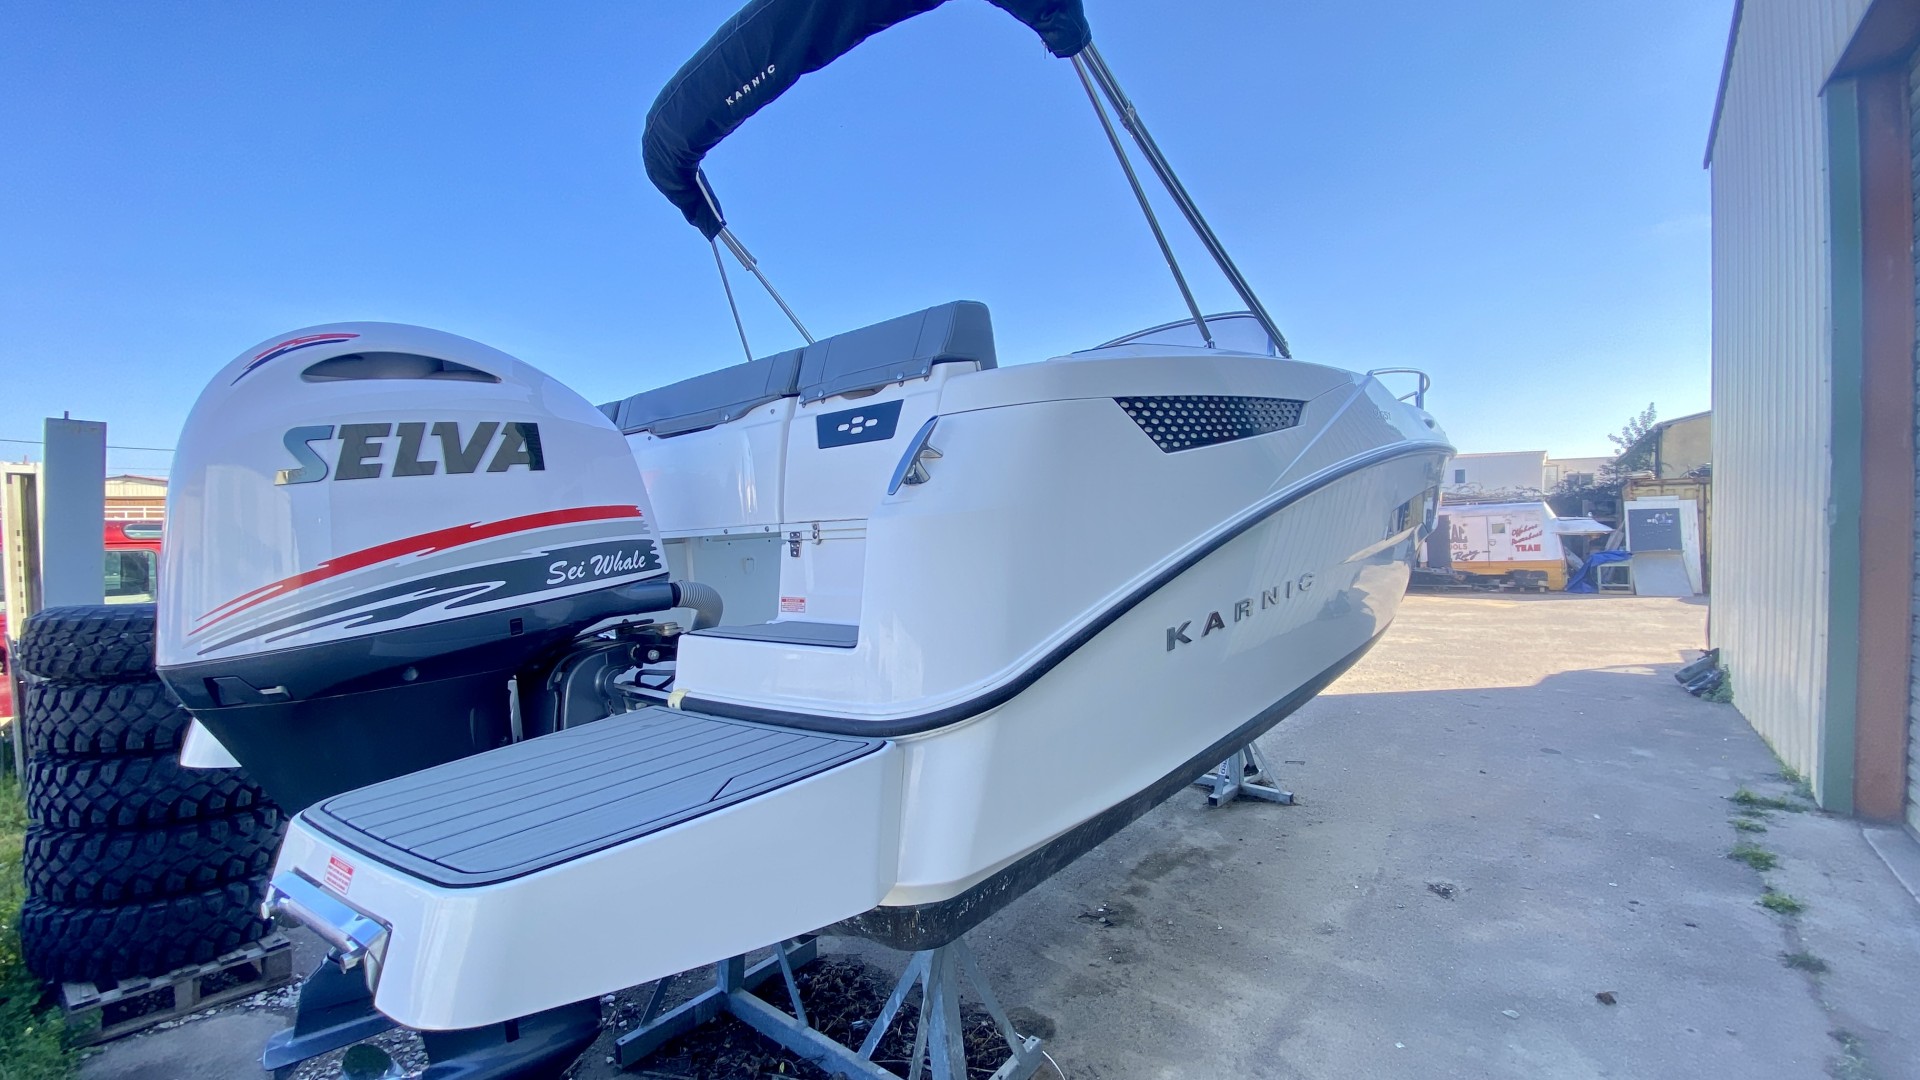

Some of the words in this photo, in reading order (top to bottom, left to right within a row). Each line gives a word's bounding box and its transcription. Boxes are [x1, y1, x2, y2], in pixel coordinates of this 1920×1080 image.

[725, 64, 776, 106] KARNIC
[274, 421, 545, 486] SELVA
[546, 560, 586, 586] Sei
[589, 549, 647, 577] Whale
[1165, 572, 1316, 652] KARNIC
